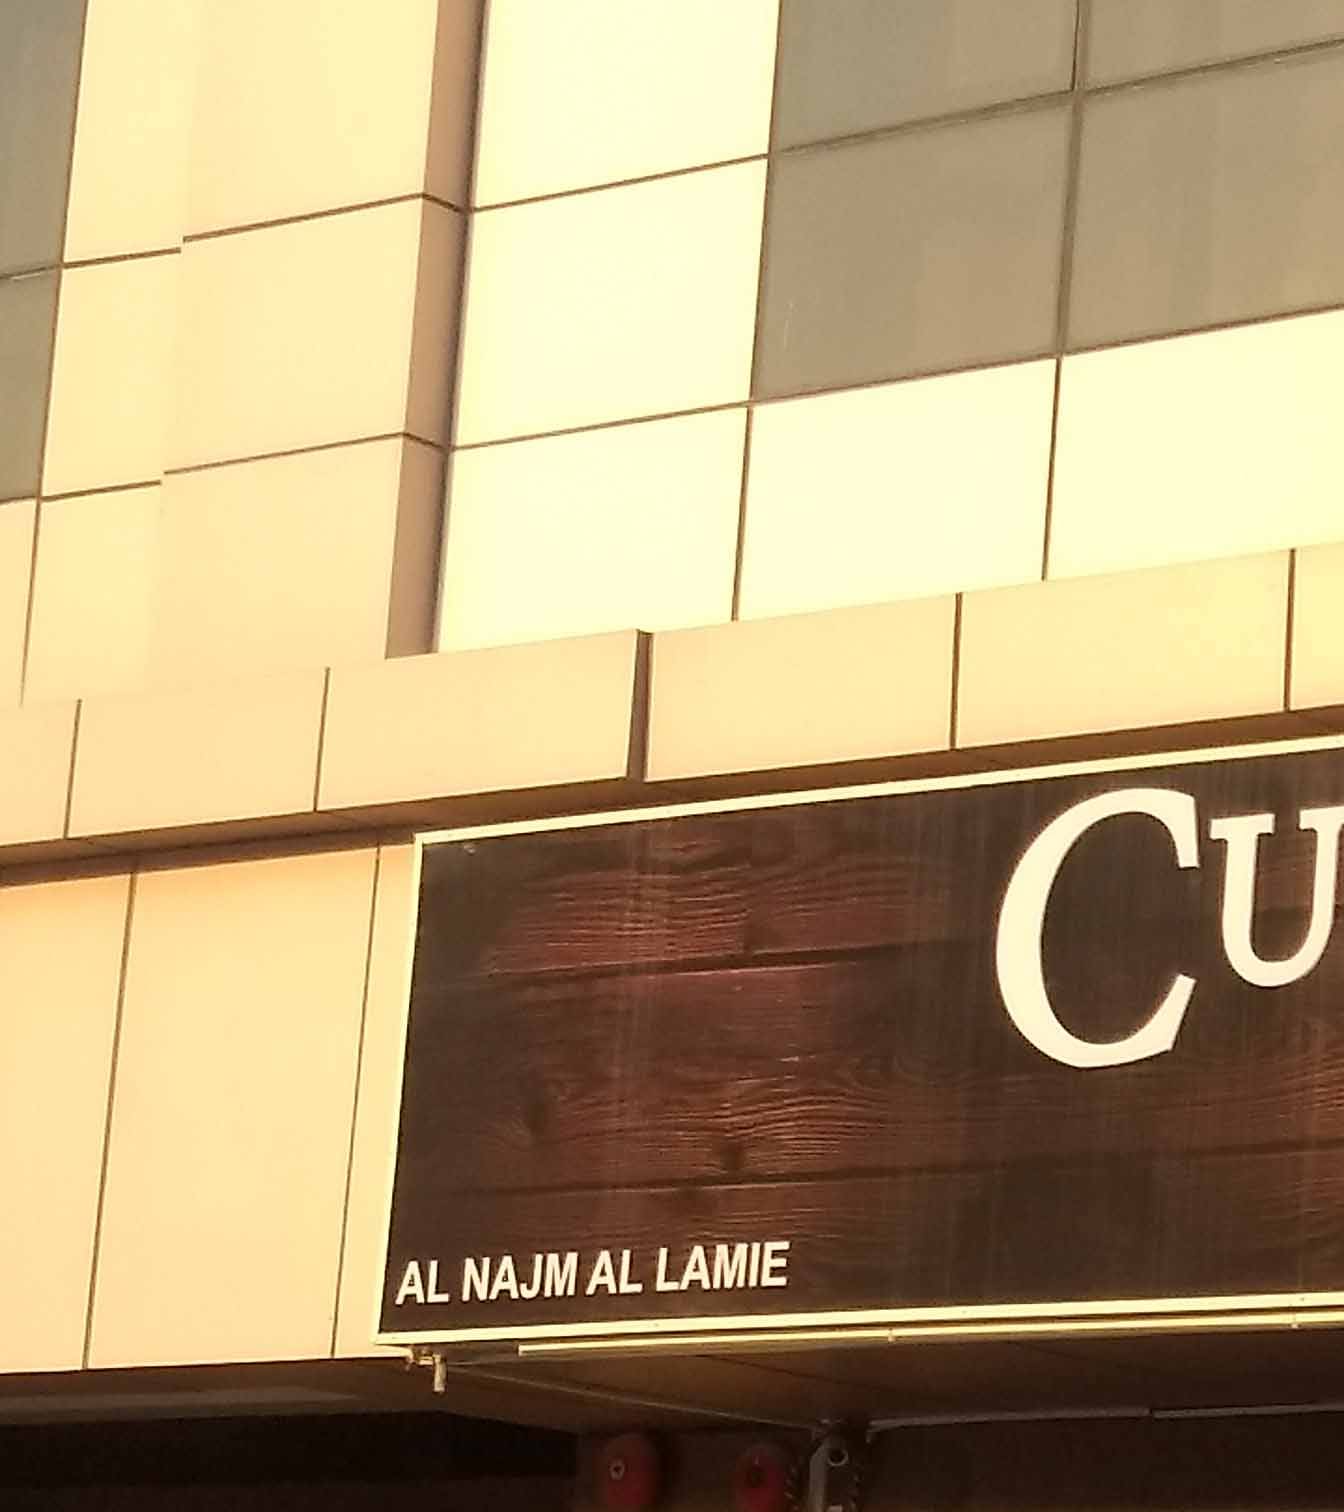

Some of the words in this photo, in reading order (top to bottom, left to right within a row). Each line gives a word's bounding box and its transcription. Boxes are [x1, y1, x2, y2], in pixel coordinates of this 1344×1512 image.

[394, 1260, 450, 1305] AL
[461, 1251, 579, 1302] NAJM
[586, 1249, 643, 1296] AL
[655, 1240, 791, 1293] LAMIE
